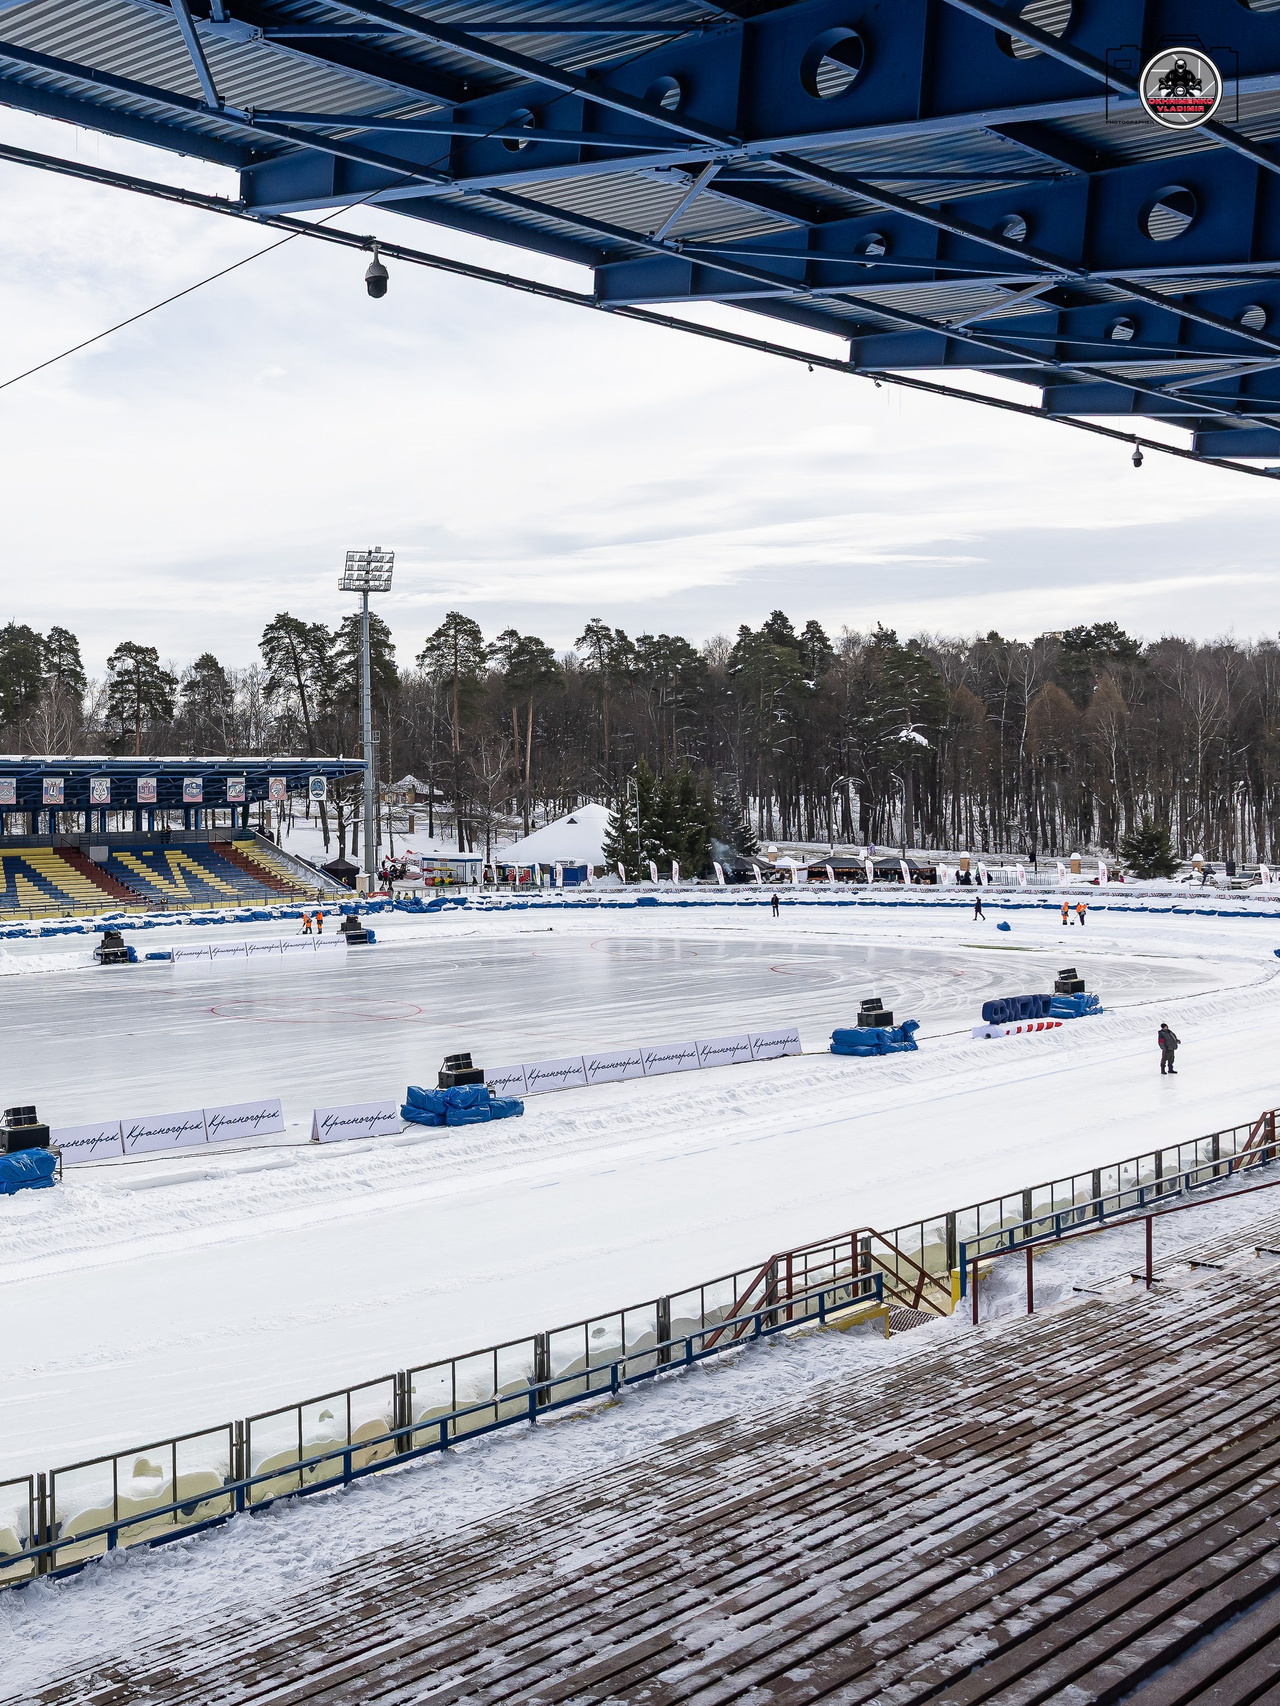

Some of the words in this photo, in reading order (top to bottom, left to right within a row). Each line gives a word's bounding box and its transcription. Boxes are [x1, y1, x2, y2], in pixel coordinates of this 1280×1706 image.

[700, 1043, 748, 1062] Красногорск
[753, 1036, 798, 1054] Красногорск
[588, 1057, 641, 1077] Красногорск
[645, 1050, 696, 1069] Красногорск
[528, 1065, 582, 1085] Красногорск
[208, 1110, 279, 1135] Красногорск
[321, 1111, 396, 1135] Красногорск
[126, 1121, 203, 1147] Красногорск
